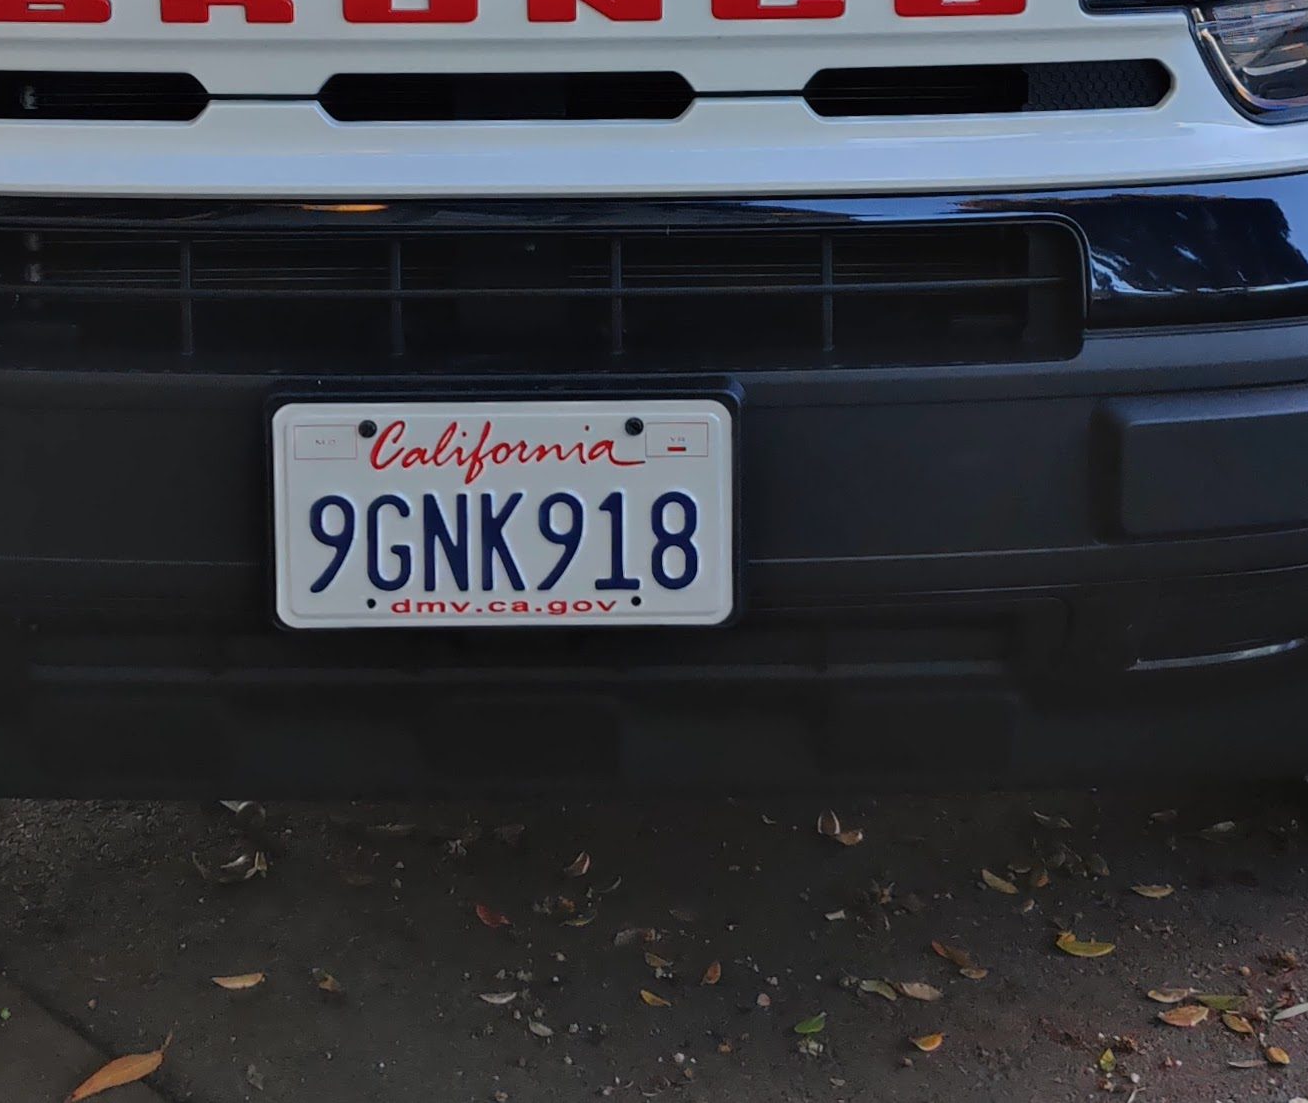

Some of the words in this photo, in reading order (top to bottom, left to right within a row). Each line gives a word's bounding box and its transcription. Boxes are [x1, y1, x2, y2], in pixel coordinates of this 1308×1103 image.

[370, 420, 645, 484] California
[310, 492, 697, 593] 9GNK918
[391, 598, 616, 614] dmv.ca.gov
